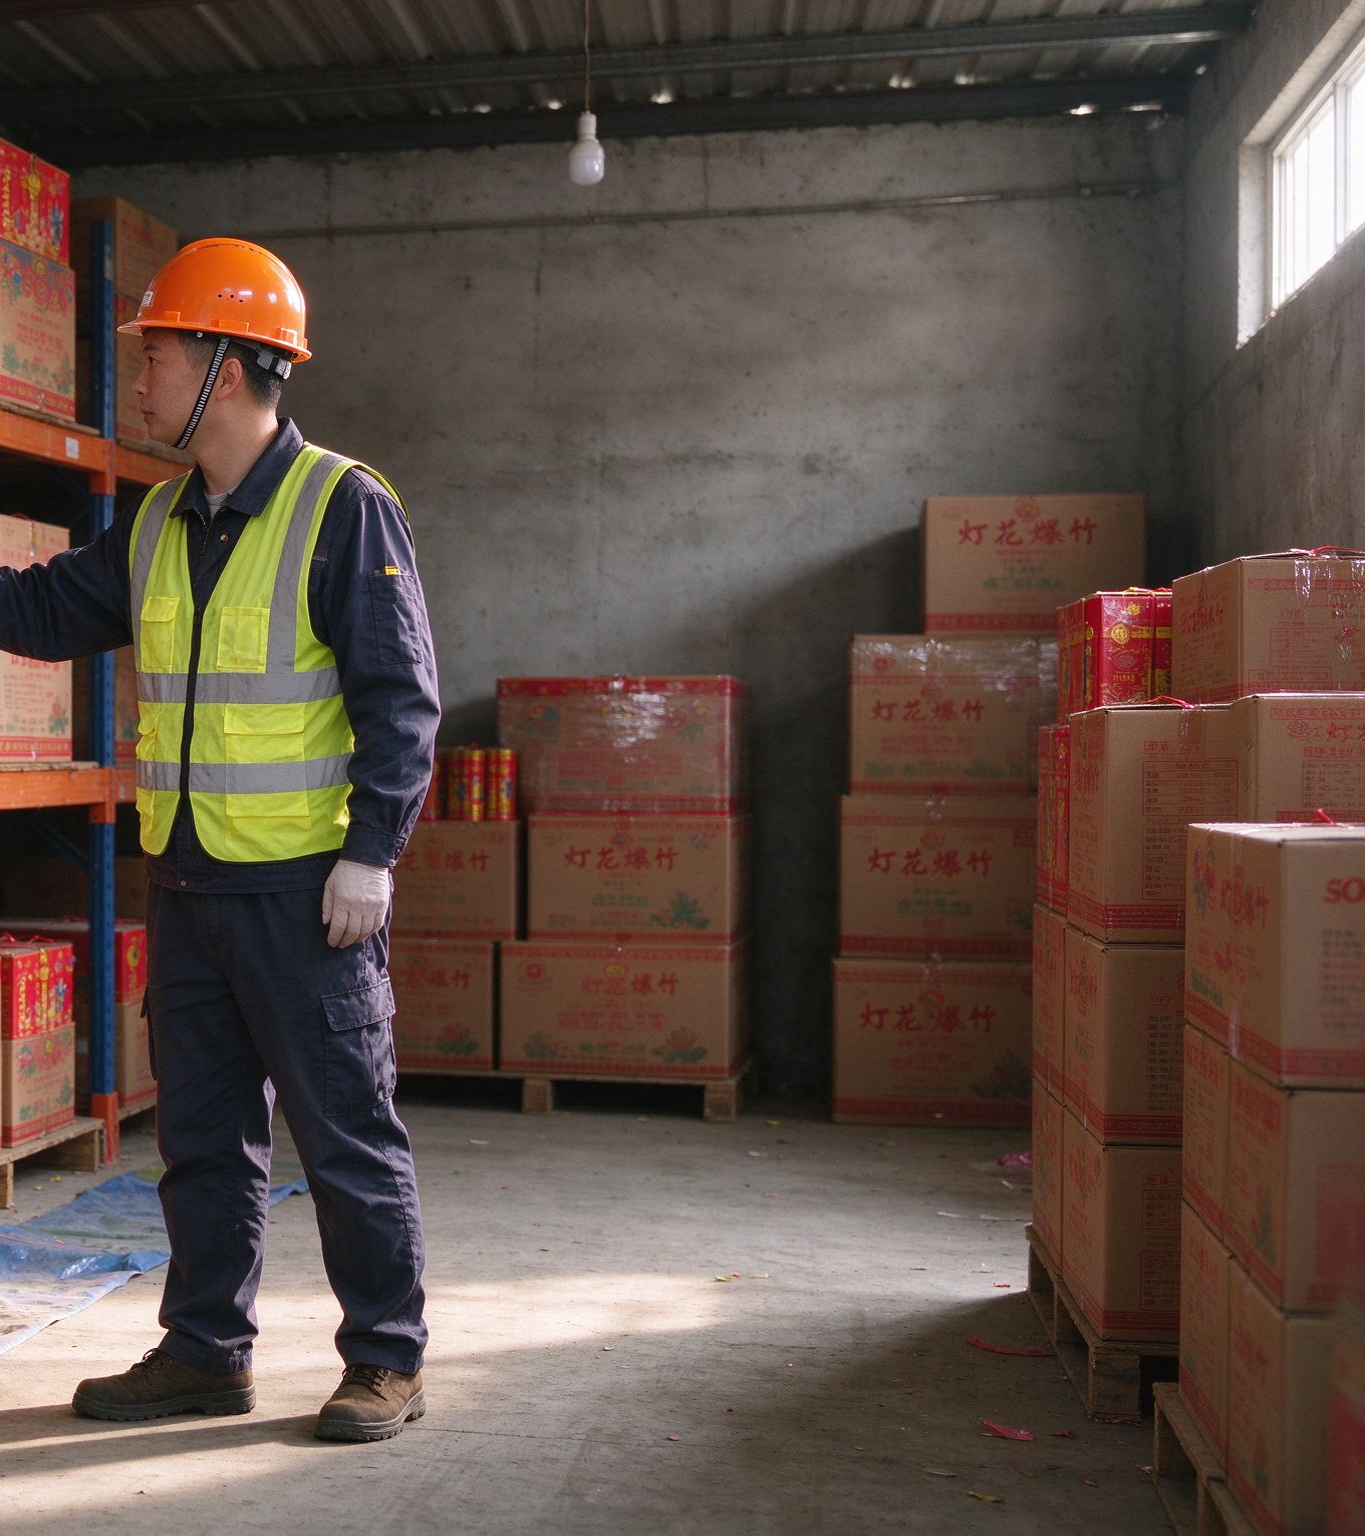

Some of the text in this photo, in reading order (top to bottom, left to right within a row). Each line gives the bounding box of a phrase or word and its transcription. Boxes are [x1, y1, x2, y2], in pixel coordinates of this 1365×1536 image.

[958, 517, 1097, 546] 灯花爆竹
[871, 701, 984, 722] 灯花爆竹
[564, 846, 677, 870] 灯花爆竹
[868, 849, 992, 876] 灯花爆竹
[860, 1003, 995, 1033] 灯花爆竹
